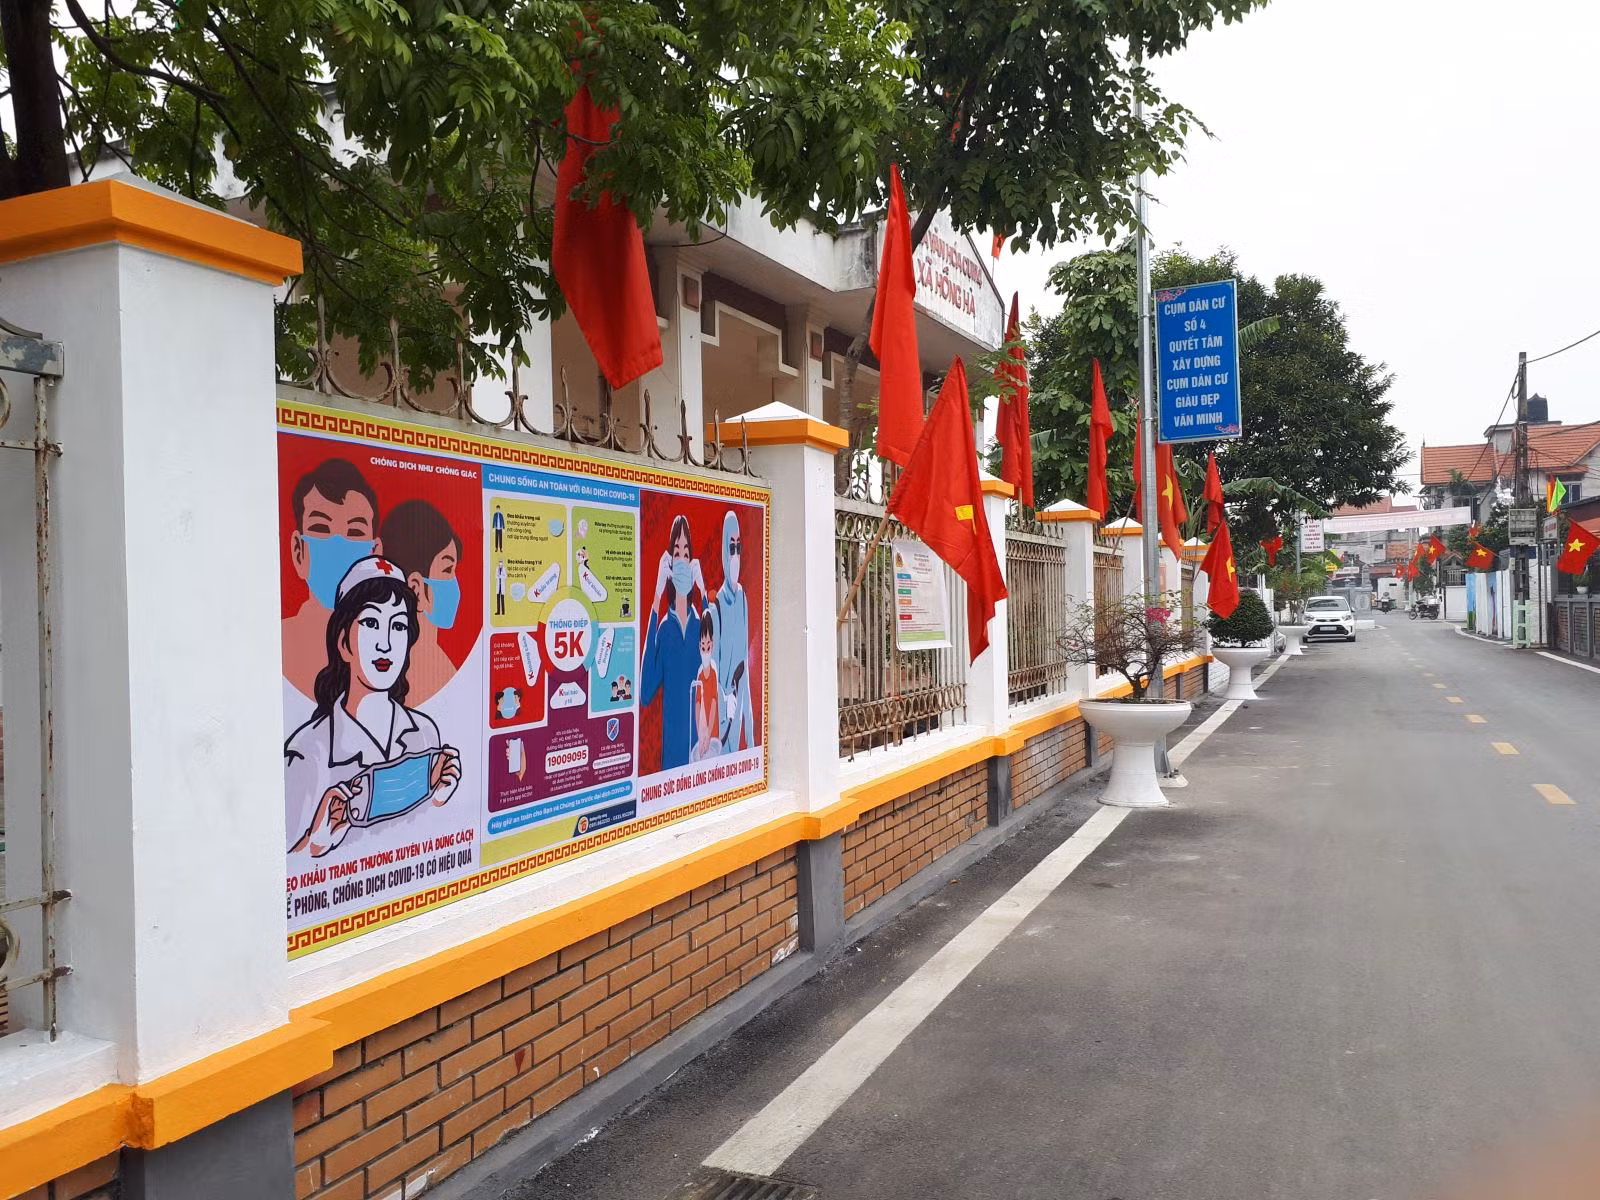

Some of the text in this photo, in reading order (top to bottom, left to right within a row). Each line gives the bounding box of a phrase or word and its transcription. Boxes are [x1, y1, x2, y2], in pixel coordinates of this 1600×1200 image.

[917, 256, 976, 317] XÃ HỒNG HÀ
[1164, 295, 1226, 317] CỤM DÂN CƯ
[1184, 315, 1206, 332] SỐ 4
[1169, 334, 1223, 353] QUYẾT TÂM
[1172, 354, 1221, 371] XÂY DỰNG
[1167, 372, 1229, 393] CỤM DÂN CƯ
[1175, 392, 1220, 408] GIÀU ĐẸP
[1174, 411, 1223, 427] VĂN MINH
[370, 456, 398, 468] CHỐNG
[399, 461, 417, 471] DỊCH
[435, 465, 459, 476] CHỐNG
[488, 472, 516, 485] CHUNG
[517, 475, 538, 488] SỐNG
[538, 480, 549, 489] AN
[549, 481, 568, 492] TOÀN
[593, 487, 609, 499] DỊCH
[609, 489, 635, 501] COVID-19
[554, 631, 584, 659] 5K
[547, 749, 587, 767] 19009095
[641, 757, 760, 803] CHUNG SỨC ĐỒNG LÒNG CHỐNG DỊCH COVID-19
[300, 863, 326, 888] KHẨU
[328, 862, 358, 882] TRANG
[359, 849, 394, 873] THƯỜNG
[395, 842, 421, 862] XUYÊN
[422, 837, 434, 854] VÀ
[435, 832, 454, 850] ĐÚNG
[456, 827, 474, 846] CÁCH
[294, 889, 330, 917] PHÒNG,
[332, 876, 364, 905] CHỐNG
[366, 874, 386, 898] DỊCH
[388, 863, 424, 888] COVID-19
[426, 855, 437, 877] CÓ
[438, 852, 456, 874] HIỆU
[457, 840, 472, 867] QUẢ
